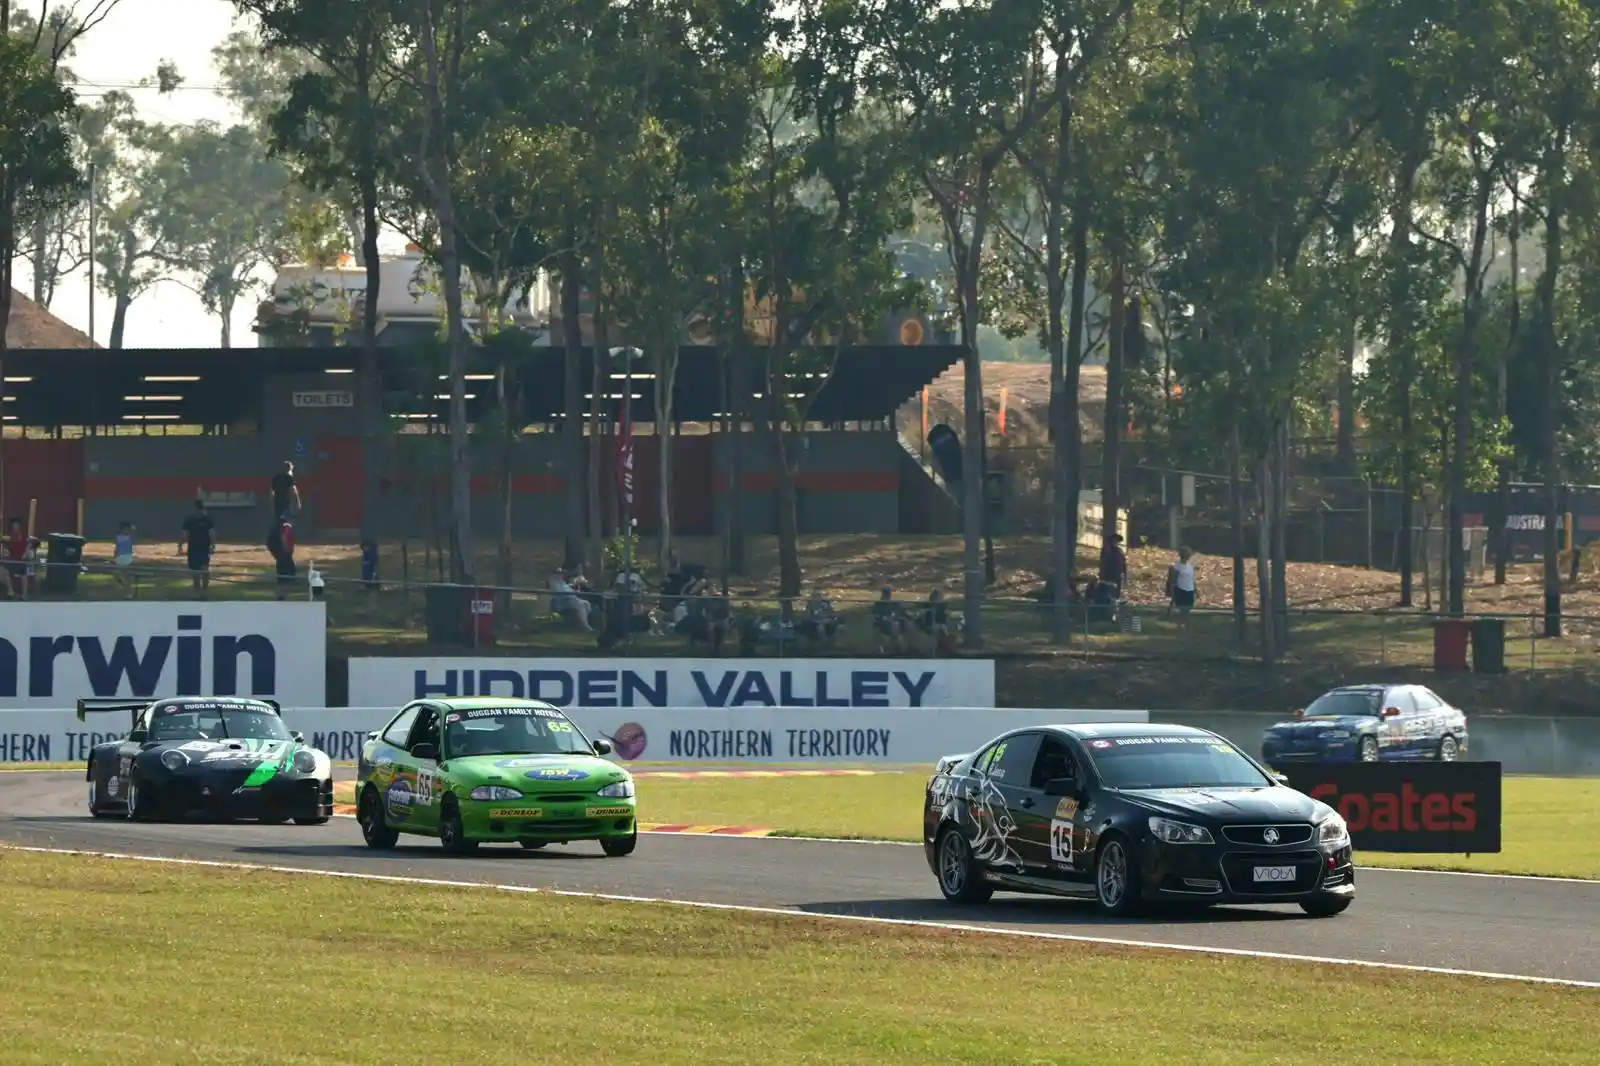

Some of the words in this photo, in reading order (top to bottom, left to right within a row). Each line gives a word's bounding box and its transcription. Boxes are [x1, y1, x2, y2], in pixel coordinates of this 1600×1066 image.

[295, 393, 351, 406] TOILETS
[414, 669, 668, 708] HIDDEN
[690, 670, 936, 708] VALLEY
[184, 702, 216, 711] DUGGAN
[467, 708, 503, 718] DUGGAN
[503, 707, 533, 717] FAMILY
[547, 720, 573, 733] 65
[669, 728, 773, 758] NORTHERN
[786, 728, 891, 757] TERRITORY
[1115, 736, 1153, 746] DUGGAN
[1154, 736, 1187, 745] FAMILY
[418, 772, 430, 802] 65
[1052, 824, 1072, 859] 15
